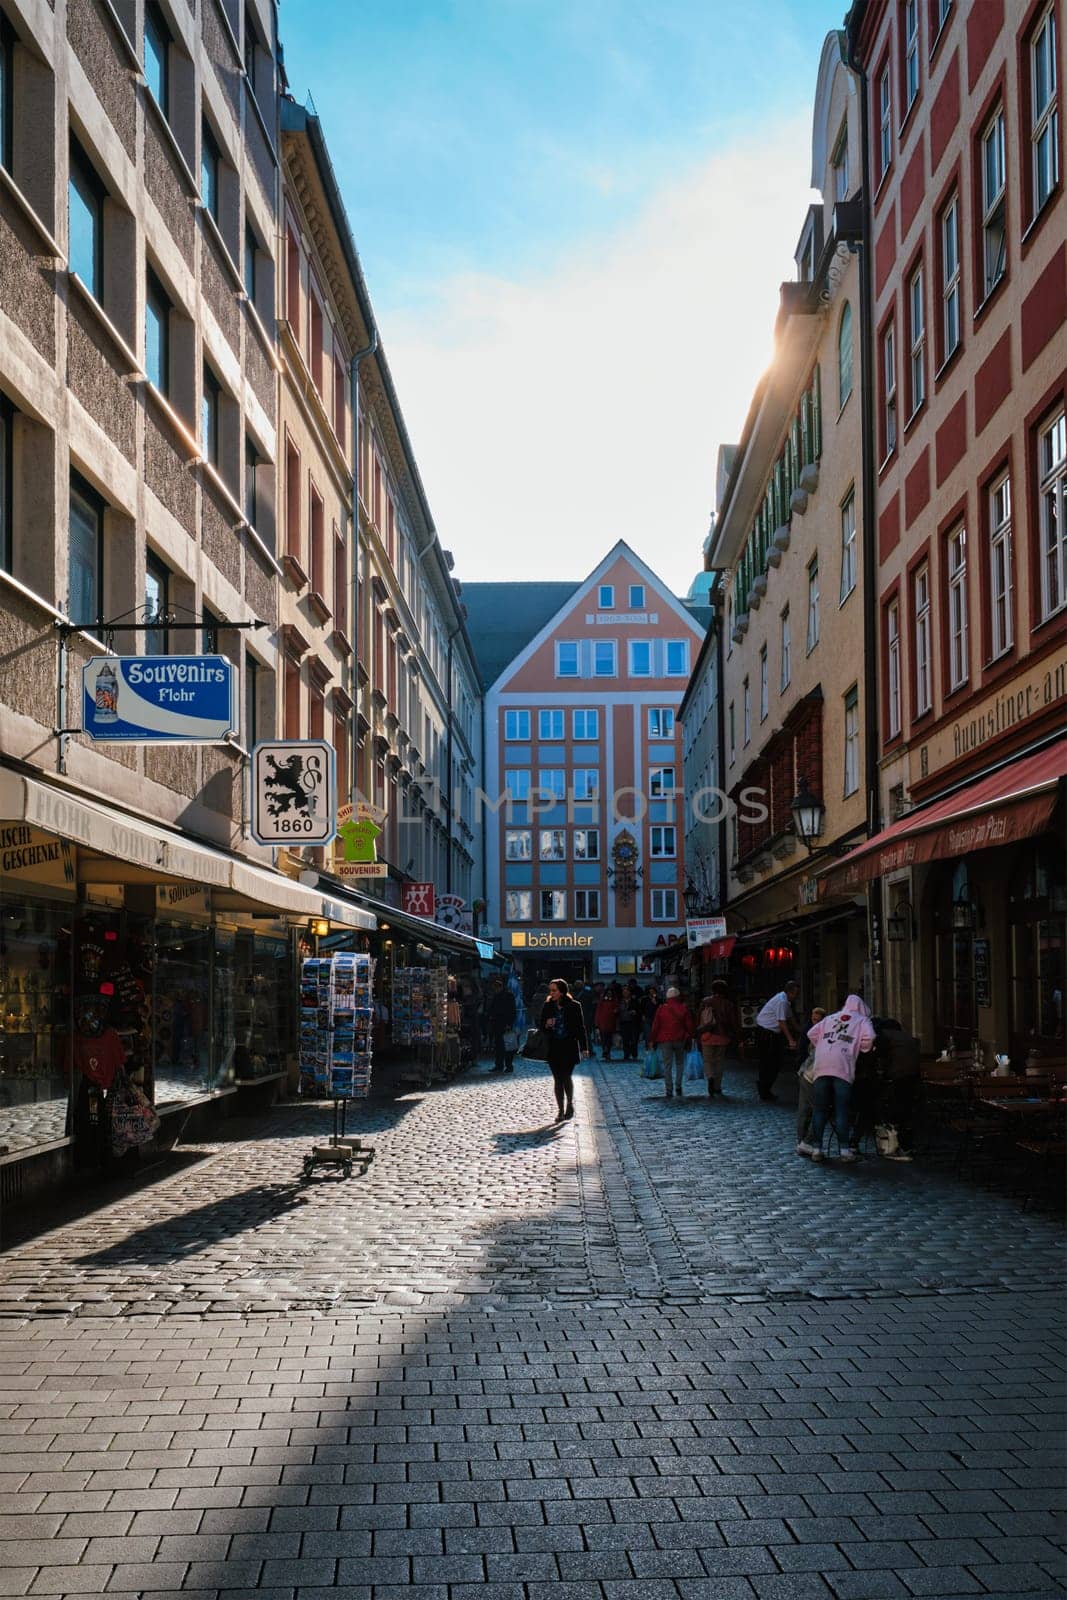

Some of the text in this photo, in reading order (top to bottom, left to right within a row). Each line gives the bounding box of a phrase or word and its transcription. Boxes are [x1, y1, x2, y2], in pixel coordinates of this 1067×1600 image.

[128, 663, 225, 684] Souvenirs
[159, 688, 195, 702] Flohr
[36, 792, 92, 841] FLOHR
[273, 819, 313, 832] 1860
[3, 842, 59, 871] GESCHENKE
[339, 866, 380, 875] SOUVENIRS
[528, 932, 593, 947] böhmler
